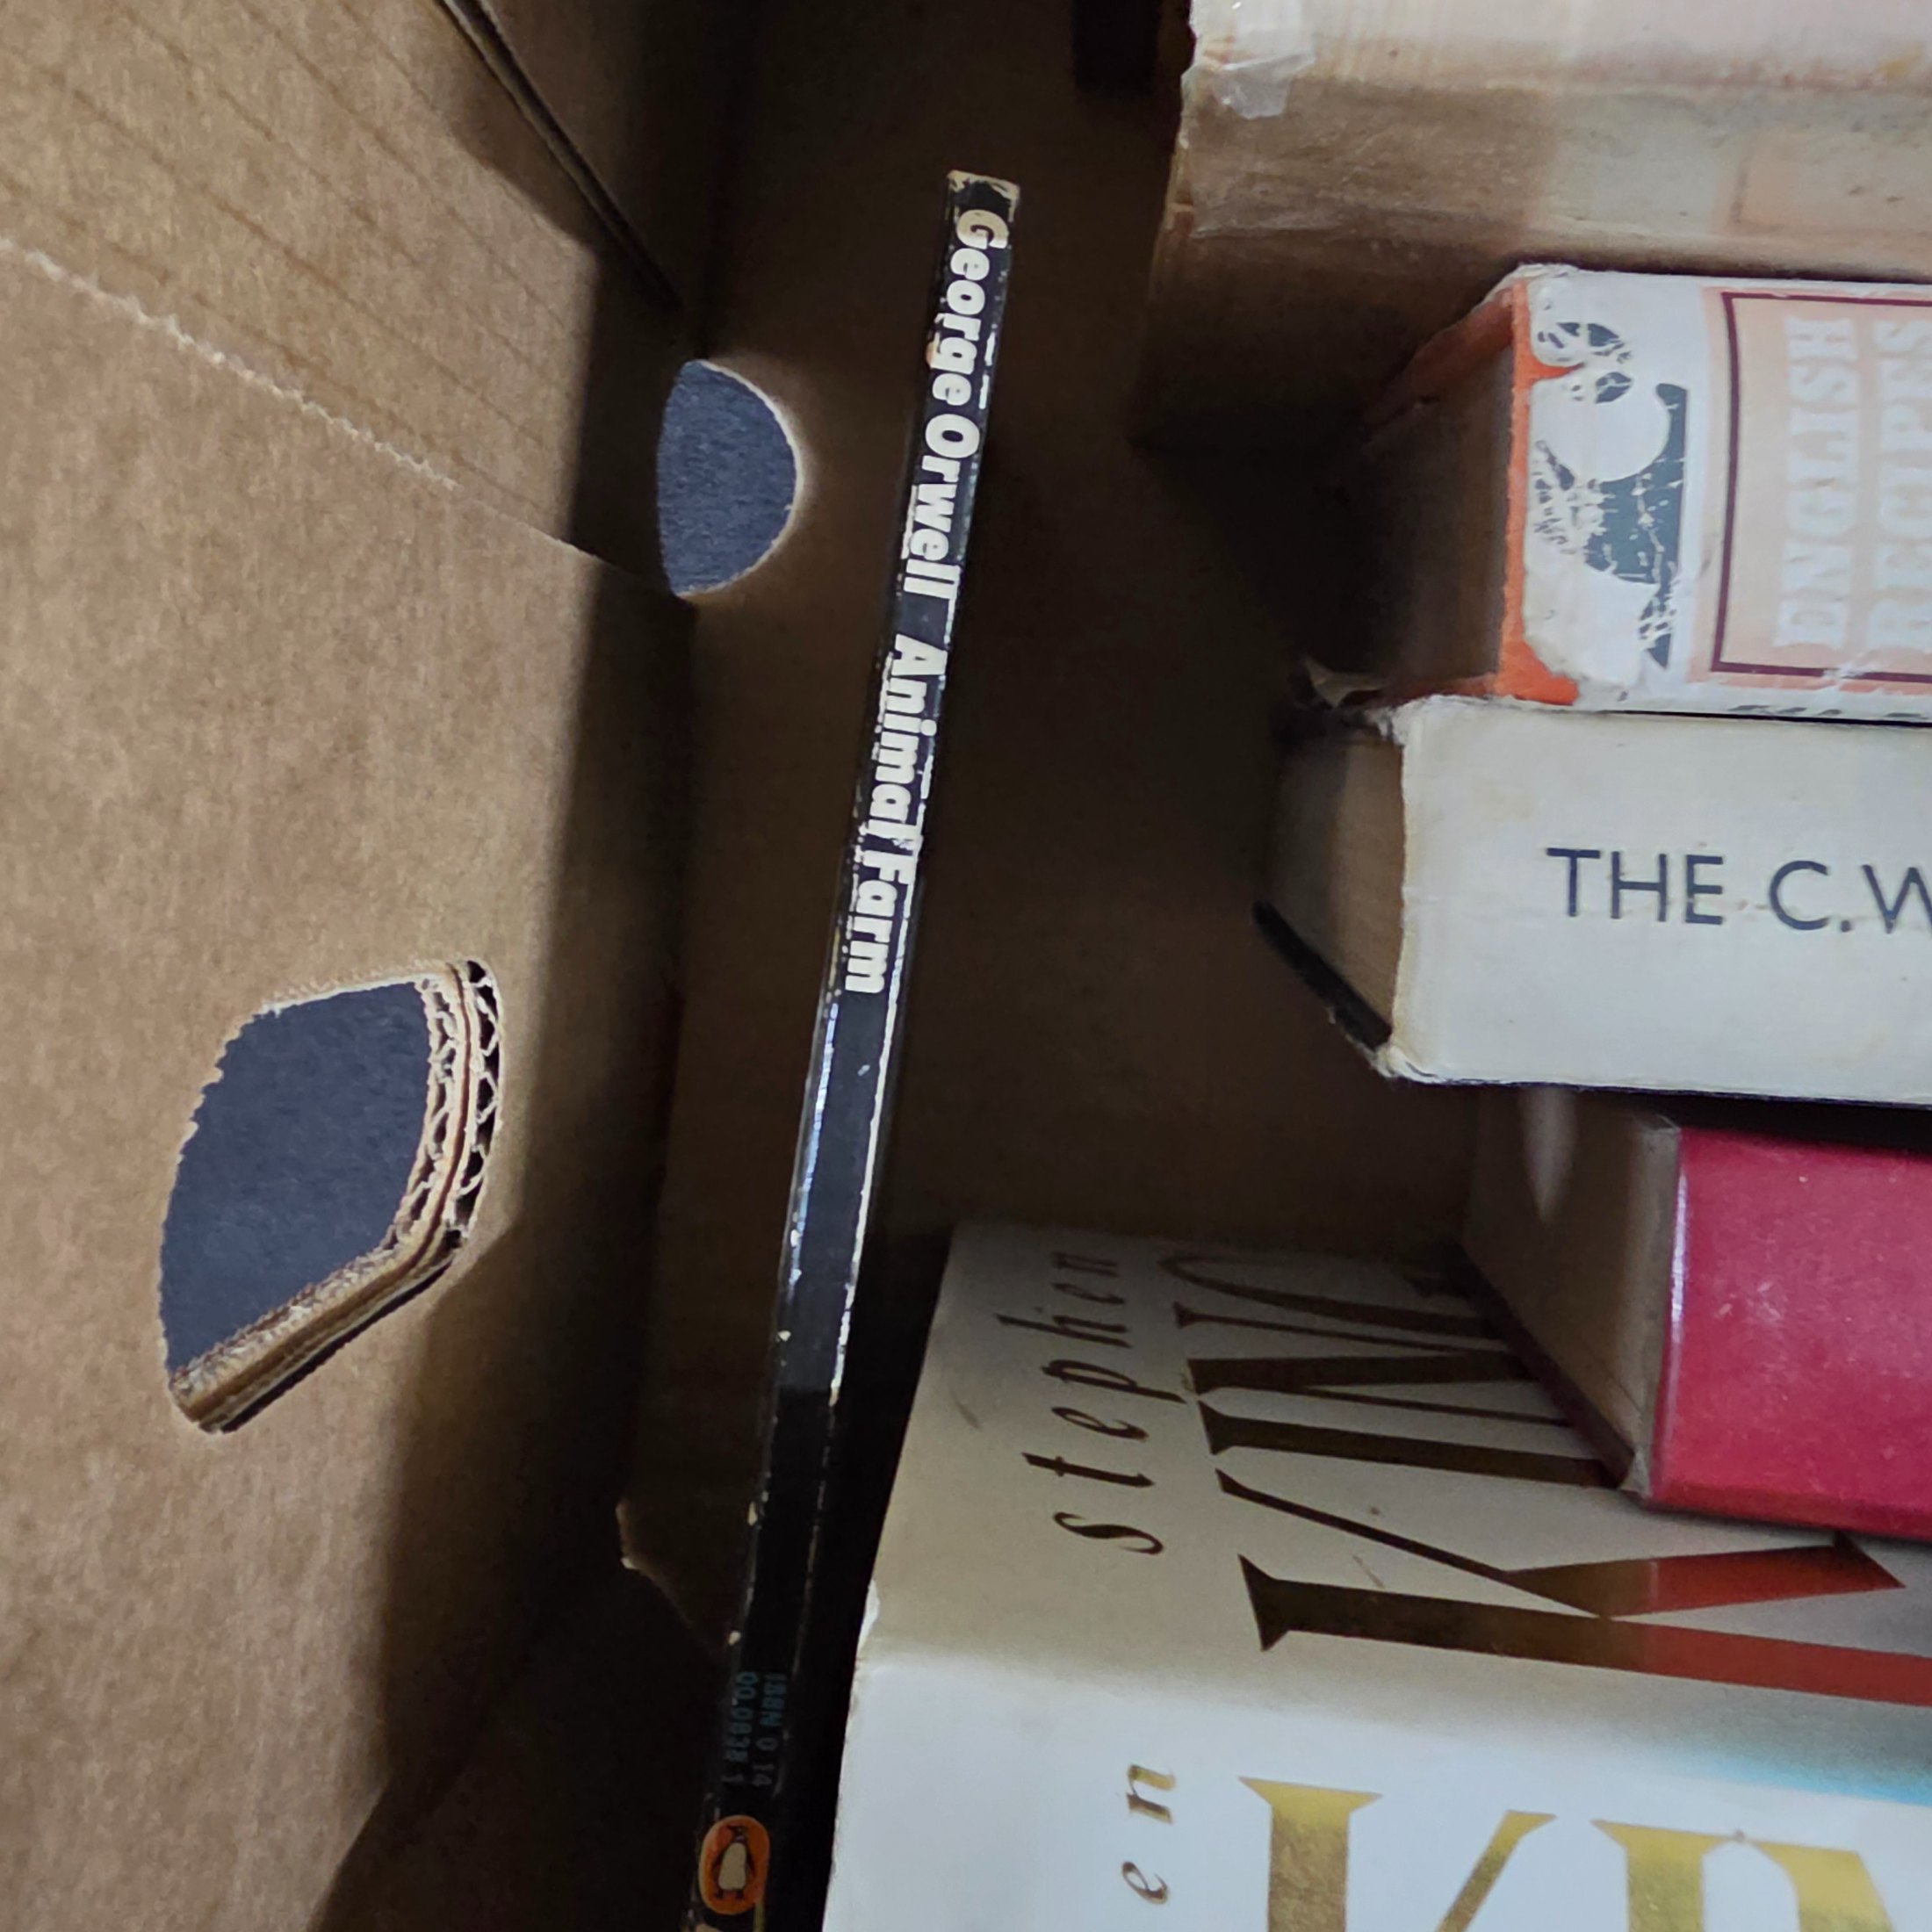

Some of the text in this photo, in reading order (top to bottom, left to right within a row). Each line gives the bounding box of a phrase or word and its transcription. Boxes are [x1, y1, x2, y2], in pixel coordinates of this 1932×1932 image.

[845, 209, 1010, 994] George Orwell Animal Farm
[1774, 316, 1860, 649] ENGLISH
[1865, 320, 1932, 652] RECIPES
[1546, 847, 1726, 926] THE
